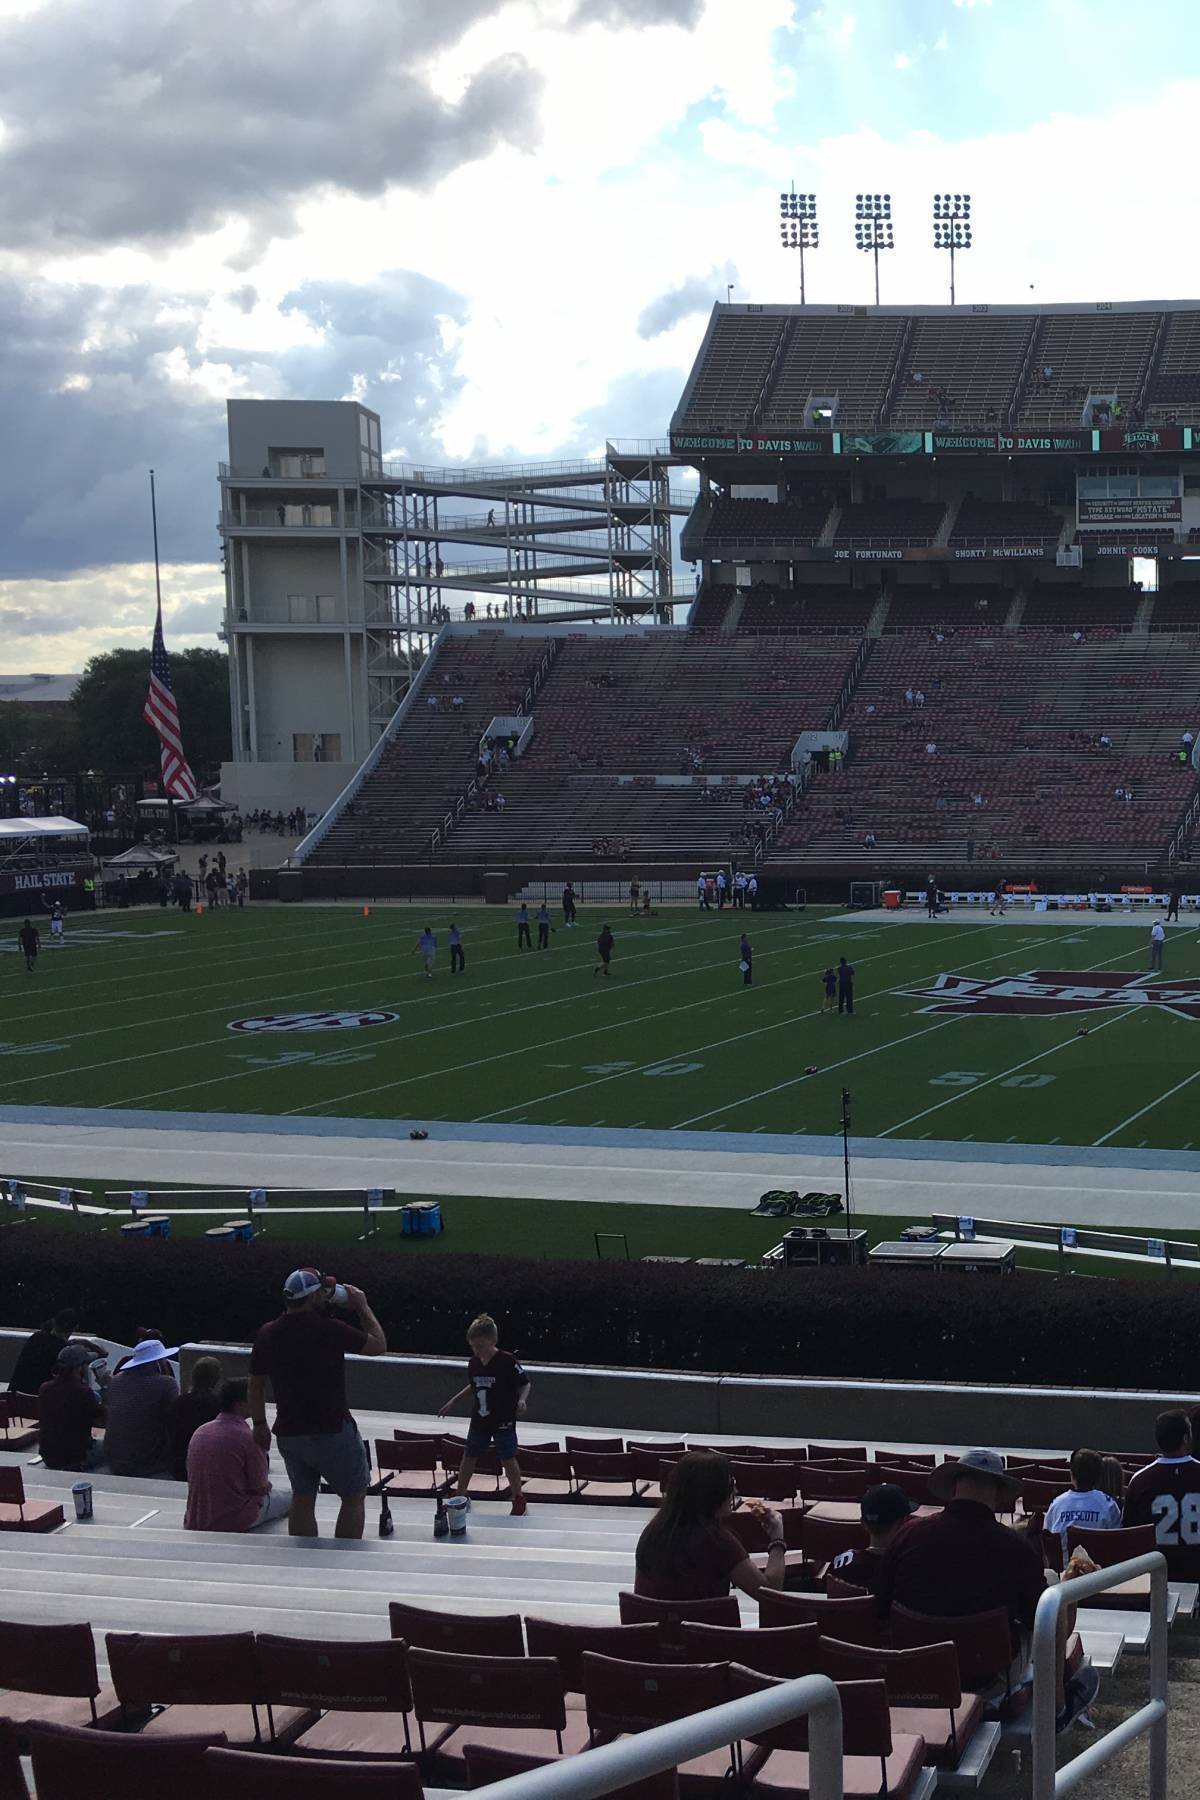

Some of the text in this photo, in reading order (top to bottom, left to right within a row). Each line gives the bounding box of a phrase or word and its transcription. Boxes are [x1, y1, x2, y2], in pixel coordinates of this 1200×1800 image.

[672, 437, 735, 449] WELCOME
[739, 439, 753, 450] TO
[758, 439, 791, 451] DAVIS
[934, 436, 995, 448] WELCOME
[1000, 437, 1013, 449] TO
[1018, 438, 1051, 449] DAVIS
[834, 550, 902, 559] JOE FORTUNATO
[955, 548, 1044, 558] SHORTY McWILLIAMS
[1097, 546, 1158, 555] JOHNIE COOKS
[15, 871, 76, 889] HAIL STATE
[928, 1071, 1058, 1088] 50
[476, 1389, 491, 1418] 1
[1060, 1510, 1101, 1523] PRESCOTT
